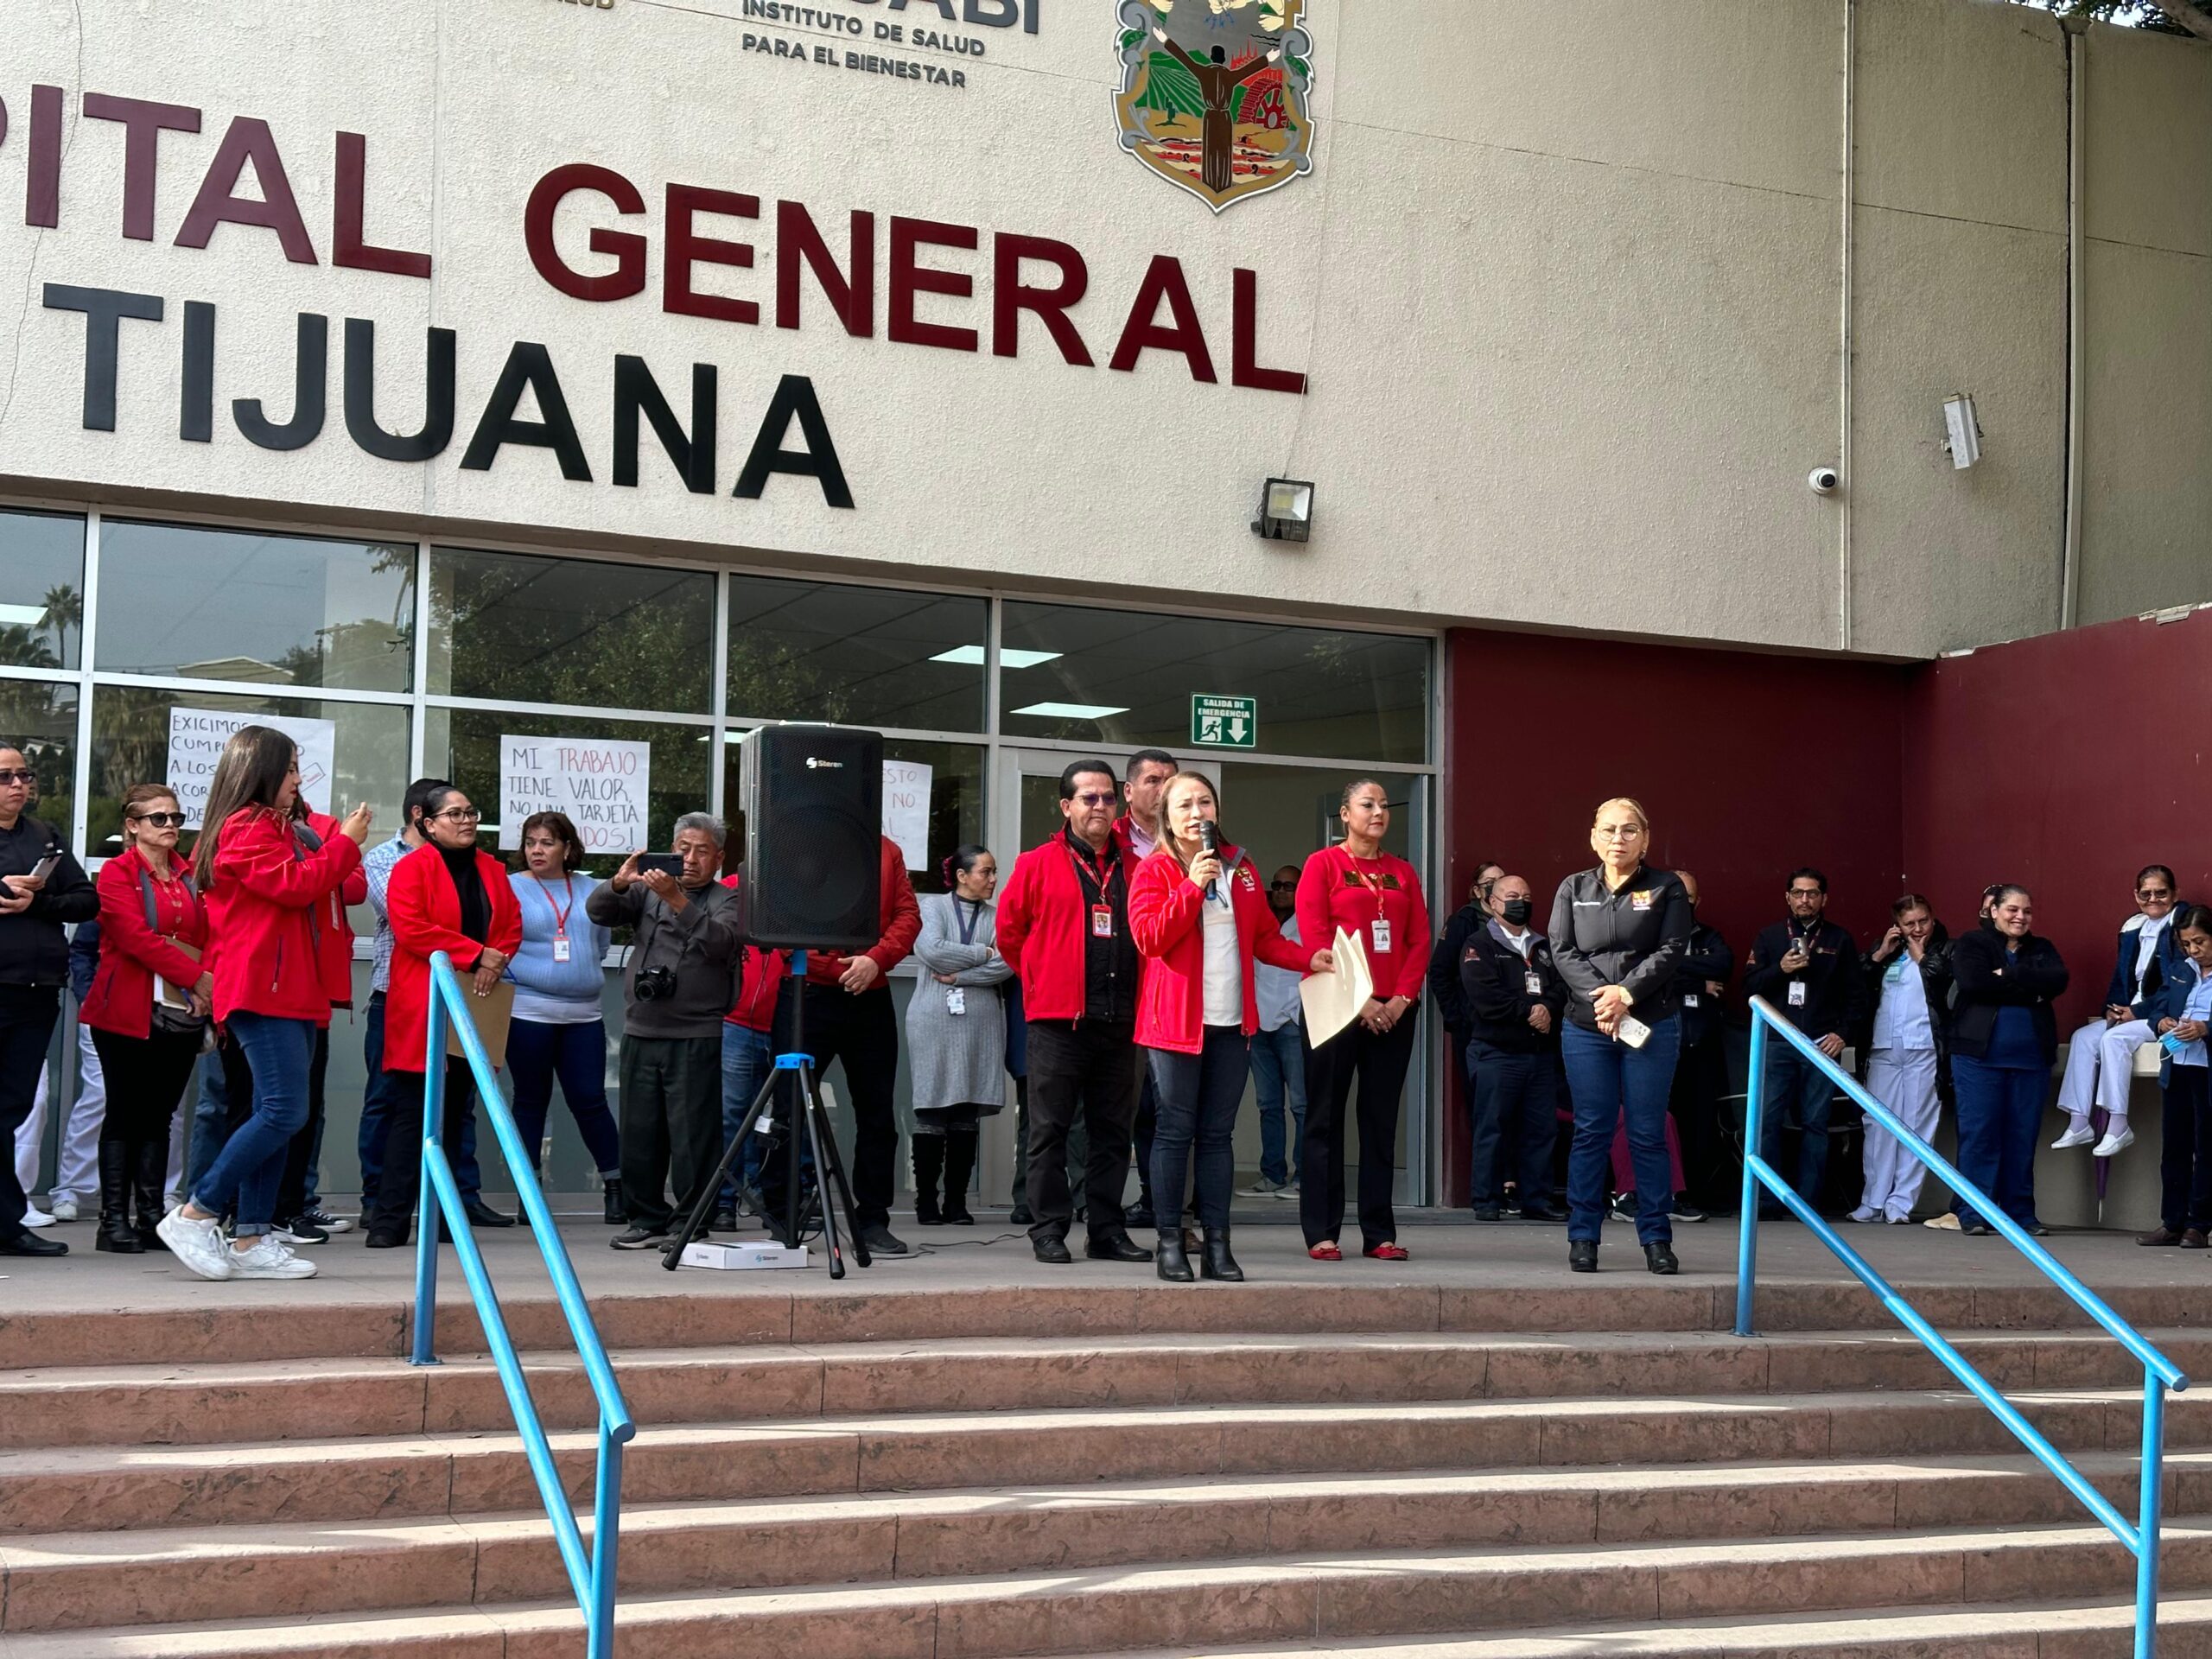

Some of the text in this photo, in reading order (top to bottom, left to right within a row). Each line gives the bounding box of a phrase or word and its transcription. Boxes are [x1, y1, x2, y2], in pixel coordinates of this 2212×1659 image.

[742, 0, 863, 35] INSTITUTO
[874, 21, 904, 42] DE
[912, 29, 986, 56] SALUD
[742, 33, 967, 88] PARA EL BIENESTAR
[0, 84, 1308, 395] ITAL GENERAL
[42, 282, 855, 509] TIJUANA
[1198, 708, 1250, 718] EMERGENCIA
[1203, 698, 1233, 709] SALIDA
[170, 759, 217, 775] A LOS
[512, 747, 637, 776] MI TRABAJO
[507, 776, 632, 804] TIENE VALOR,
[893, 793, 916, 809] NO
[510, 799, 531, 816] NO
[577, 804, 639, 823] TARJETA
